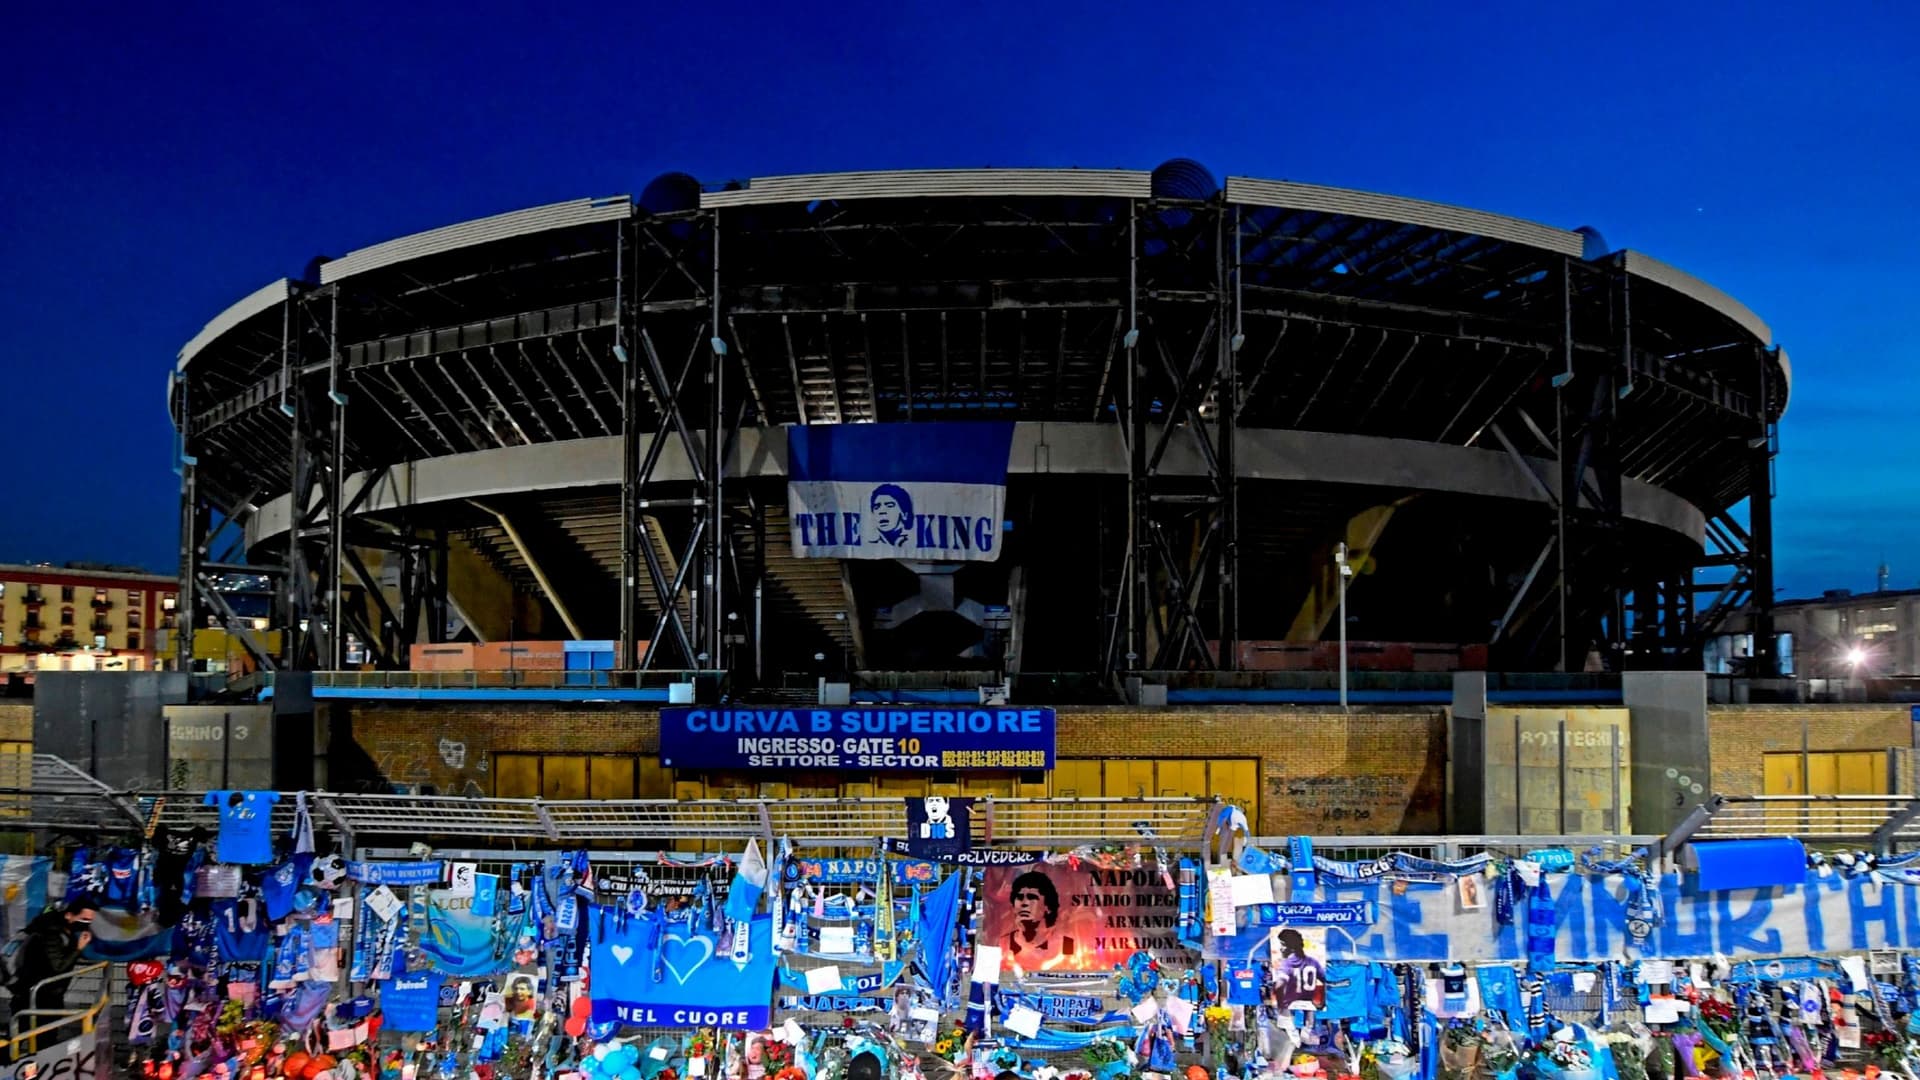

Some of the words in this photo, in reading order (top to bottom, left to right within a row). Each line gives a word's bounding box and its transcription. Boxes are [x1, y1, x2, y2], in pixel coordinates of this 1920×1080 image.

[796, 512, 862, 547] THE
[915, 513, 993, 553] KING
[686, 711, 800, 733] CURVA
[811, 711, 832, 732] B
[840, 711, 1041, 733] SUPERIORE
[234, 726, 248, 740] 3
[897, 738, 921, 754] 10
[748, 755, 840, 767] SETTORE
[858, 755, 939, 767] SECTOR
[828, 862, 898, 874] NAPOI
[1071, 894, 1131, 906] STADIO
[1277, 905, 1313, 915] FORZA
[1316, 912, 1352, 922] NAPOLI
[1293, 966, 1317, 993] 10
[617, 1006, 657, 1023] NEL
[674, 1010, 749, 1025] CUORE
